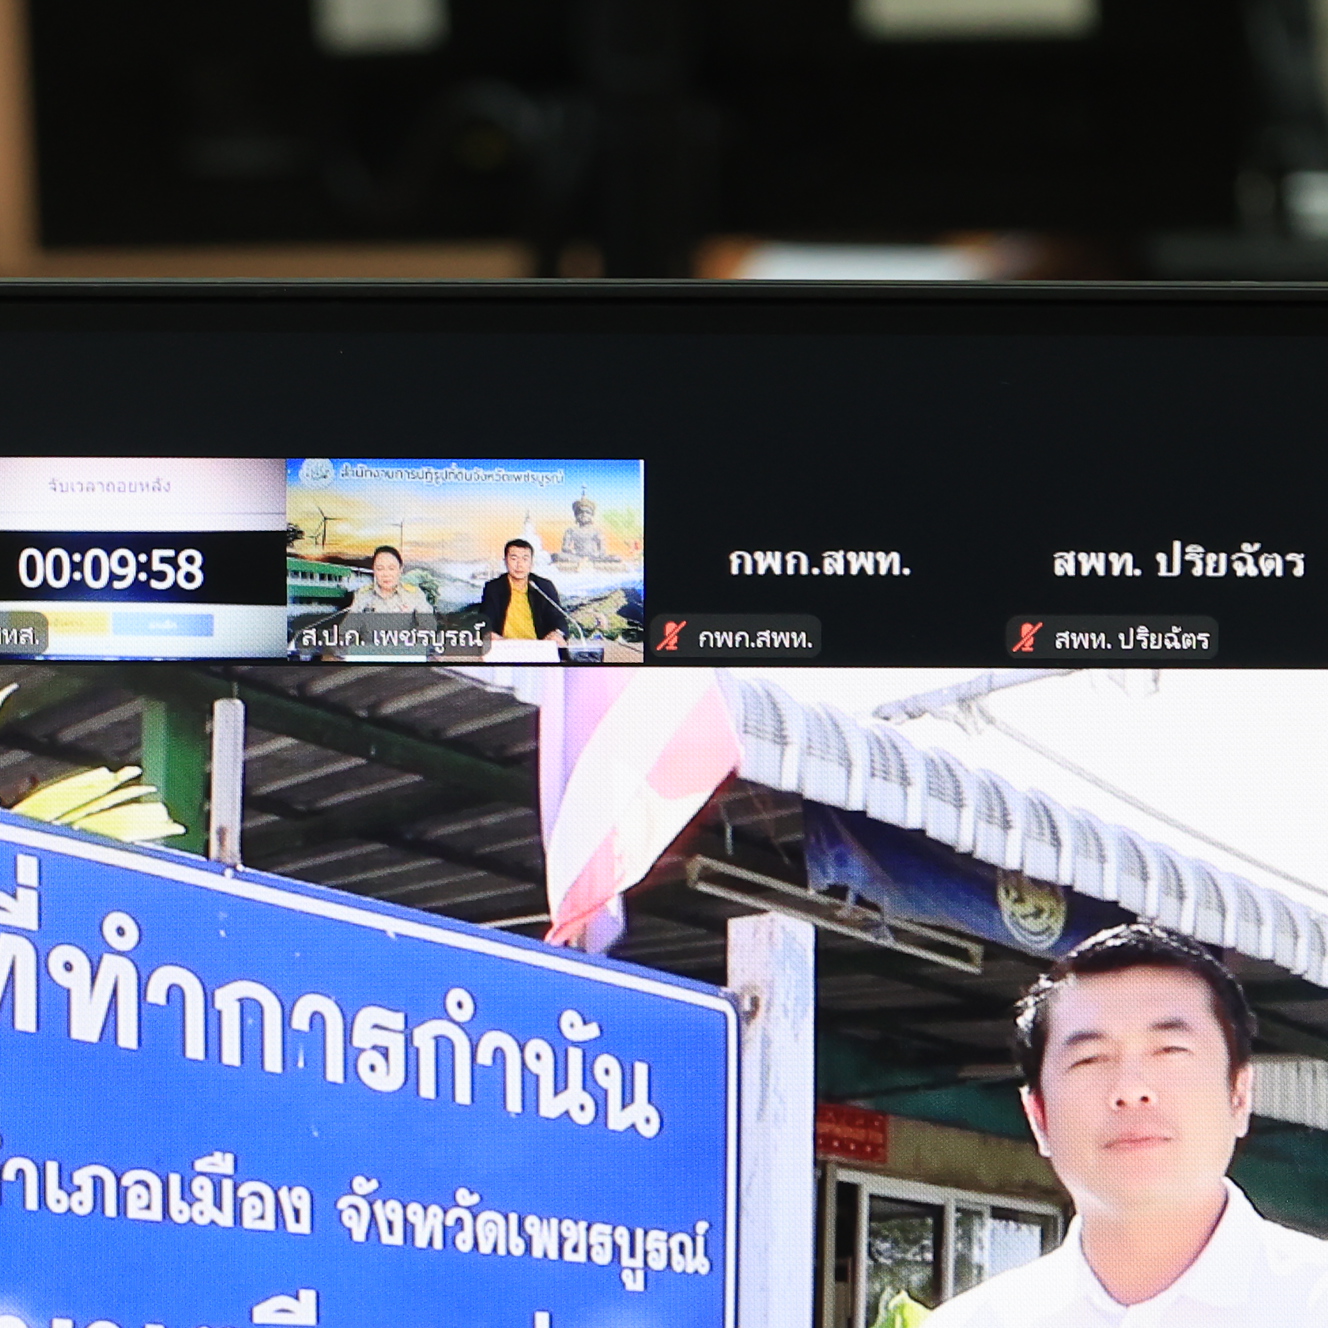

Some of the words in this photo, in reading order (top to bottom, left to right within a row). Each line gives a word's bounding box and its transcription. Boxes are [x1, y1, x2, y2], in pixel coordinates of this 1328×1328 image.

[18, 547, 204, 590] 00:09:58
[729, 548, 912, 577] กพก.สพท.
[1053, 549, 1142, 578] สพท.
[1156, 540, 1305, 578] ปริยฉัตร
[374, 622, 484, 652] เพชรบูรณ์
[698, 627, 813, 650] กพก.สพท.
[1055, 629, 1112, 651] สพท.
[1119, 625, 1210, 651] ปริยฉัตร
[336, 1177, 711, 1291] จังหวัดเพชรบูรณ์
